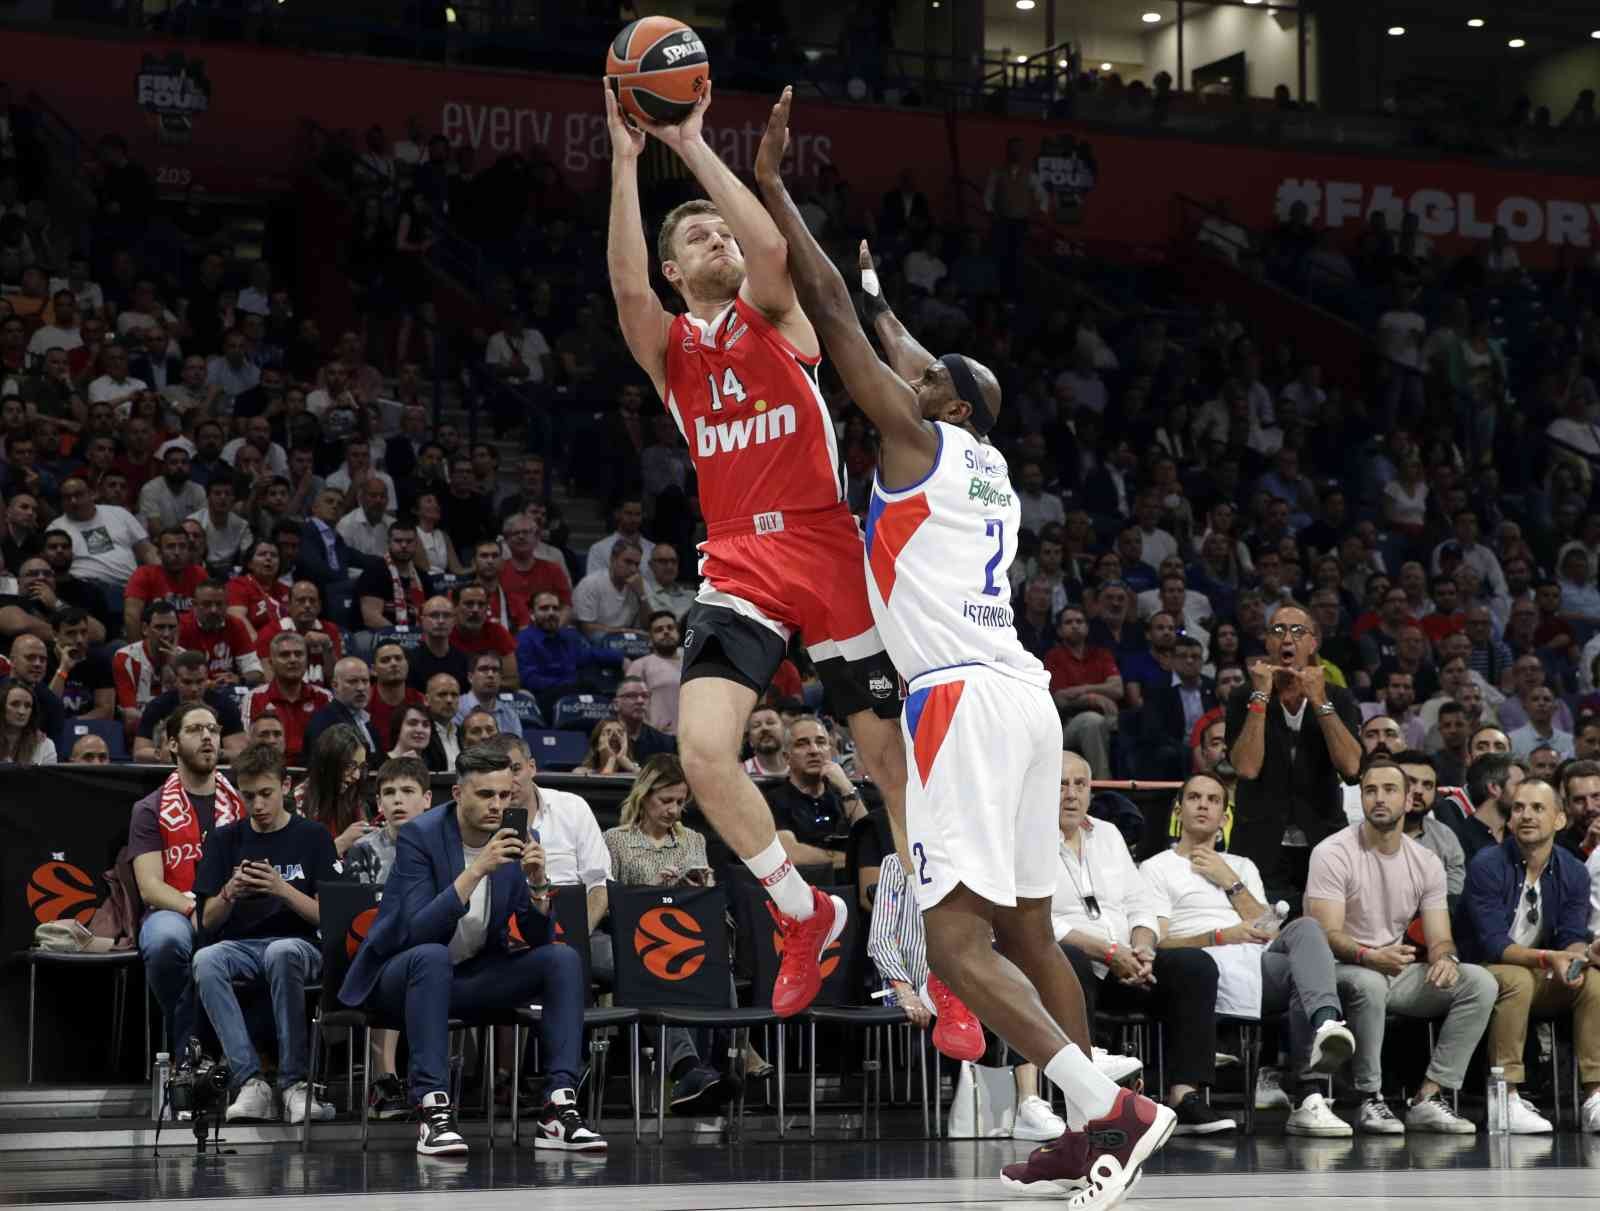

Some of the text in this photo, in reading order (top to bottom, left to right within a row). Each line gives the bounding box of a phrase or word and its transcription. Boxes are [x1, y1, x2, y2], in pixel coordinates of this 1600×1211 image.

[708, 367, 747, 411] 14
[694, 400, 796, 457] bwin
[981, 519, 1004, 596] 2
[912, 842, 932, 885] 2
